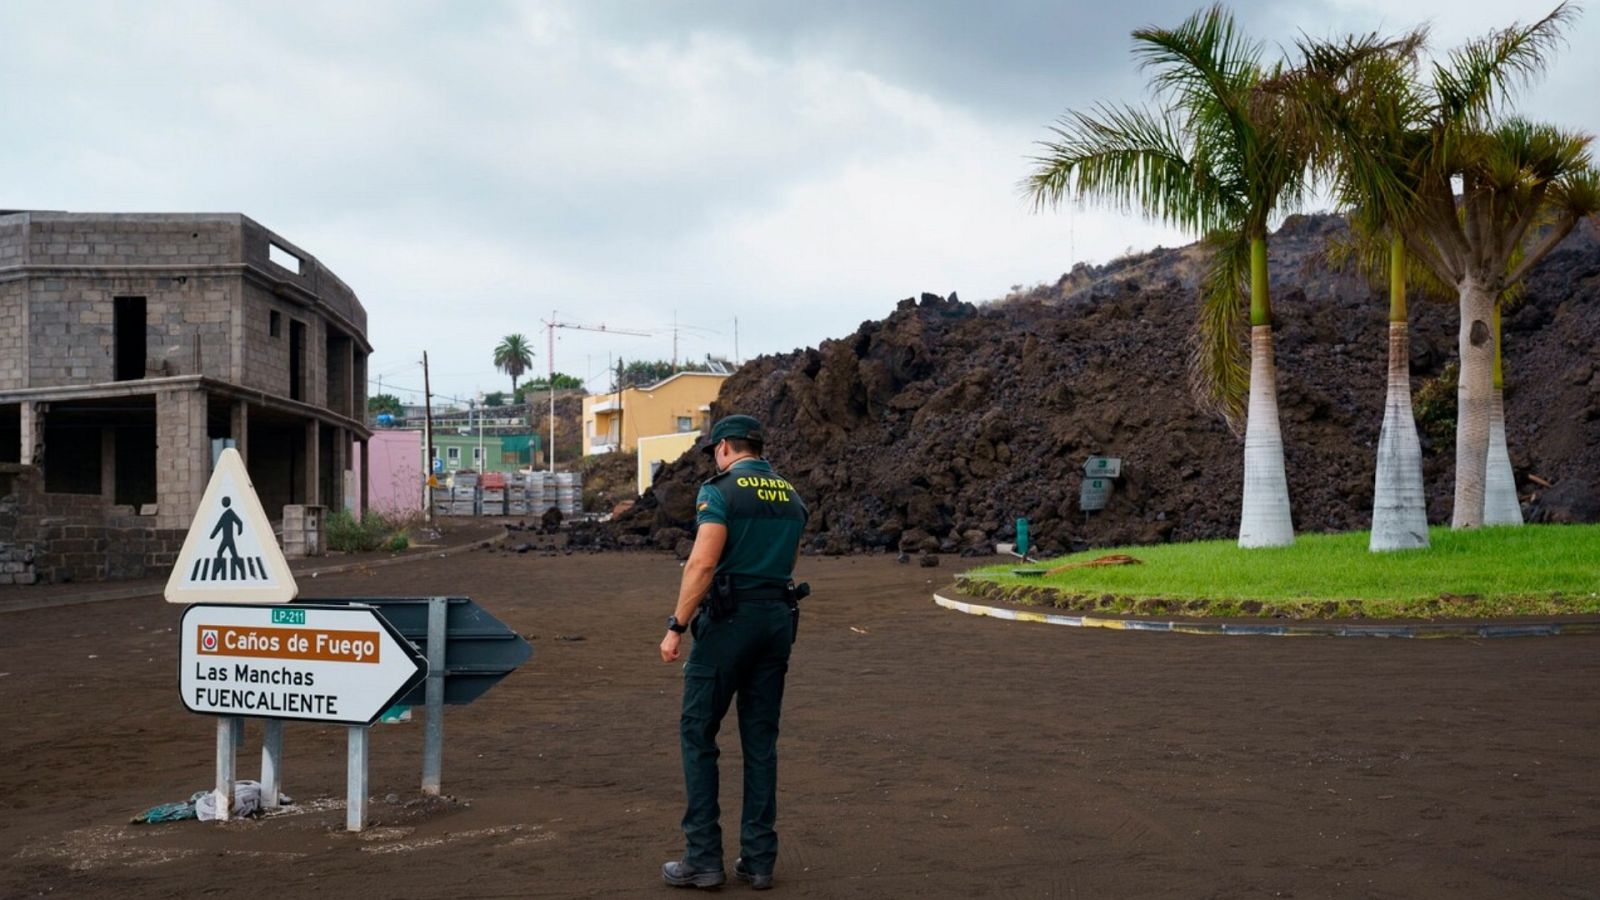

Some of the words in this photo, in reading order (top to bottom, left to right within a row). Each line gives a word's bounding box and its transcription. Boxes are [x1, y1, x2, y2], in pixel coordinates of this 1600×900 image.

[757, 489, 789, 502] CIVIL
[274, 611, 304, 623] LP-211
[224, 630, 280, 652] Caños
[287, 634, 308, 653] de
[316, 634, 375, 661] Fuego
[196, 662, 228, 681] Las
[235, 664, 314, 686] Manchas
[196, 688, 337, 714] FUENCALIENTE
